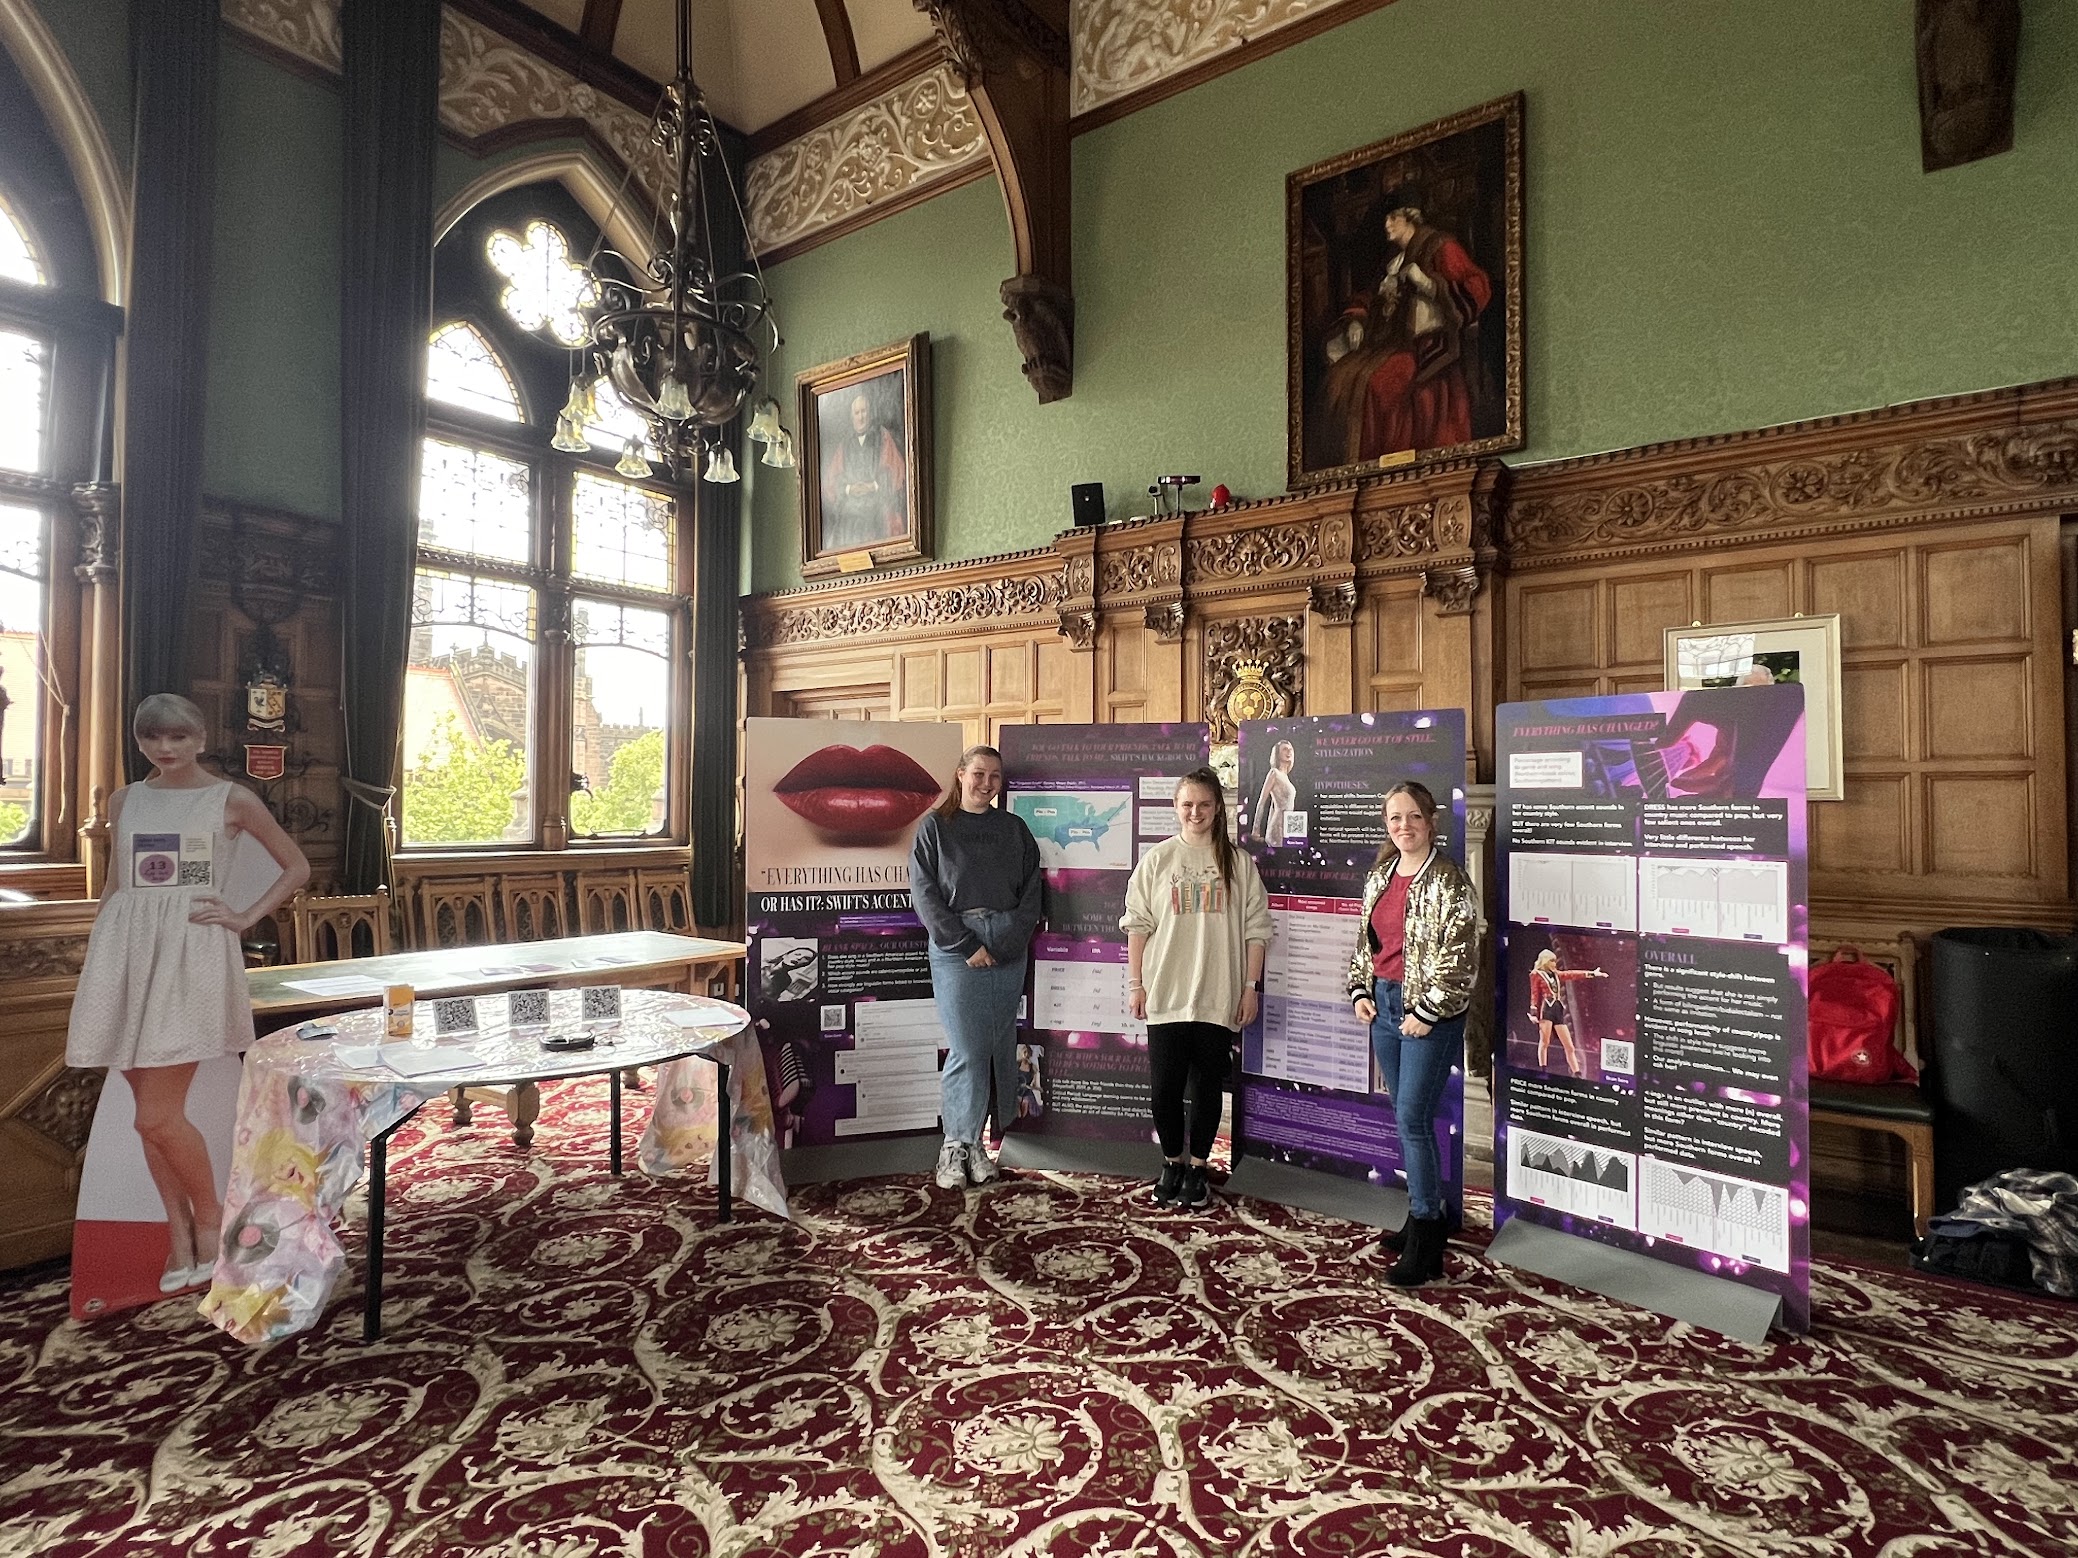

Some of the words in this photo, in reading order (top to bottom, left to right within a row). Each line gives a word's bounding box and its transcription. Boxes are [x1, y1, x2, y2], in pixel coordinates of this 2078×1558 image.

[1513, 726, 1574, 736] EVERYTHING
[1576, 724, 1597, 734] HAS
[1600, 721, 1658, 733] CHANGED?
[856, 866, 882, 883] HAS
[761, 896, 777, 912] OR
[781, 896, 803, 912] HAS
[826, 894, 869, 910] SWIFT'S
[872, 893, 913, 908] ACCENT
[1645, 950, 1698, 965] OVERALL
[1676, 968, 1708, 976] significant
[1710, 971, 1742, 980] style-shift
[1744, 974, 1775, 983] between
